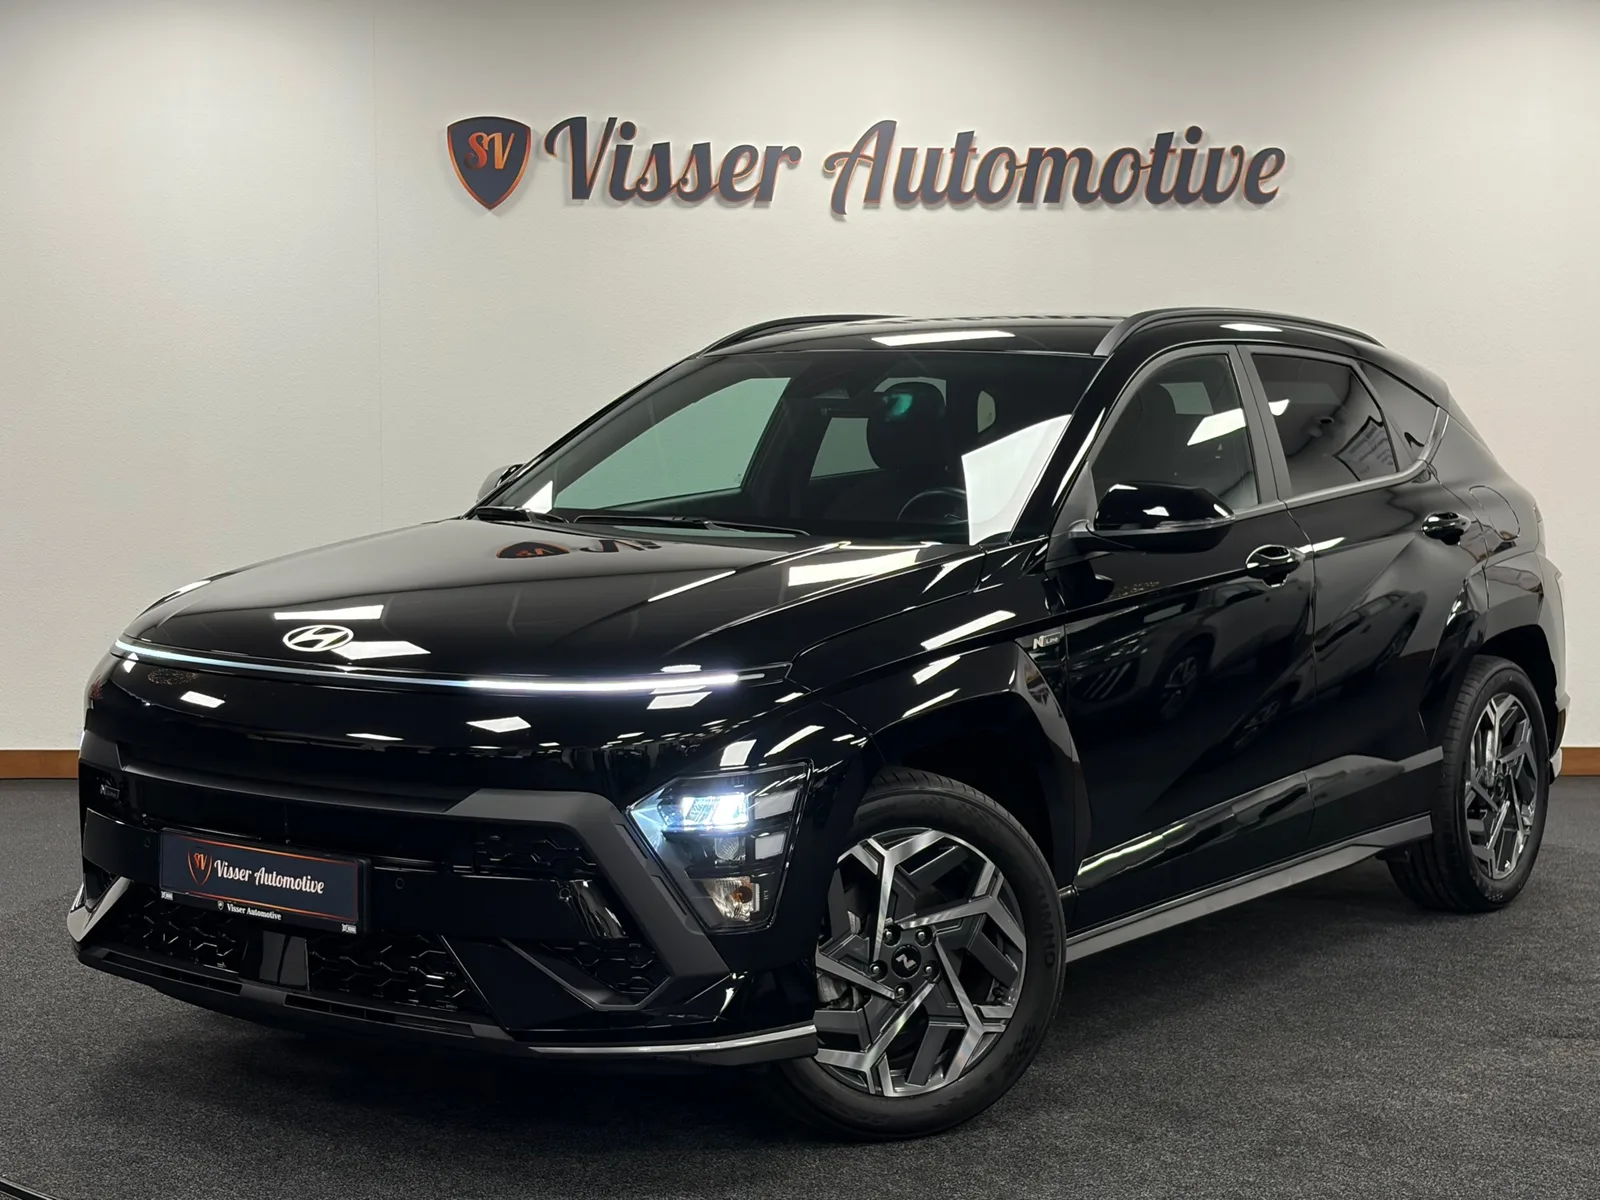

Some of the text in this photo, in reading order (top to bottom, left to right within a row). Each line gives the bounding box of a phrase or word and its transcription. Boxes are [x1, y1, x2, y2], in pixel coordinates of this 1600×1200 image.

[464, 132, 515, 169] SV
[544, 116, 1286, 215] Visser Automotive
[214, 859, 325, 894] Visser Automotive
[227, 903, 282, 921] Visser Automotive
